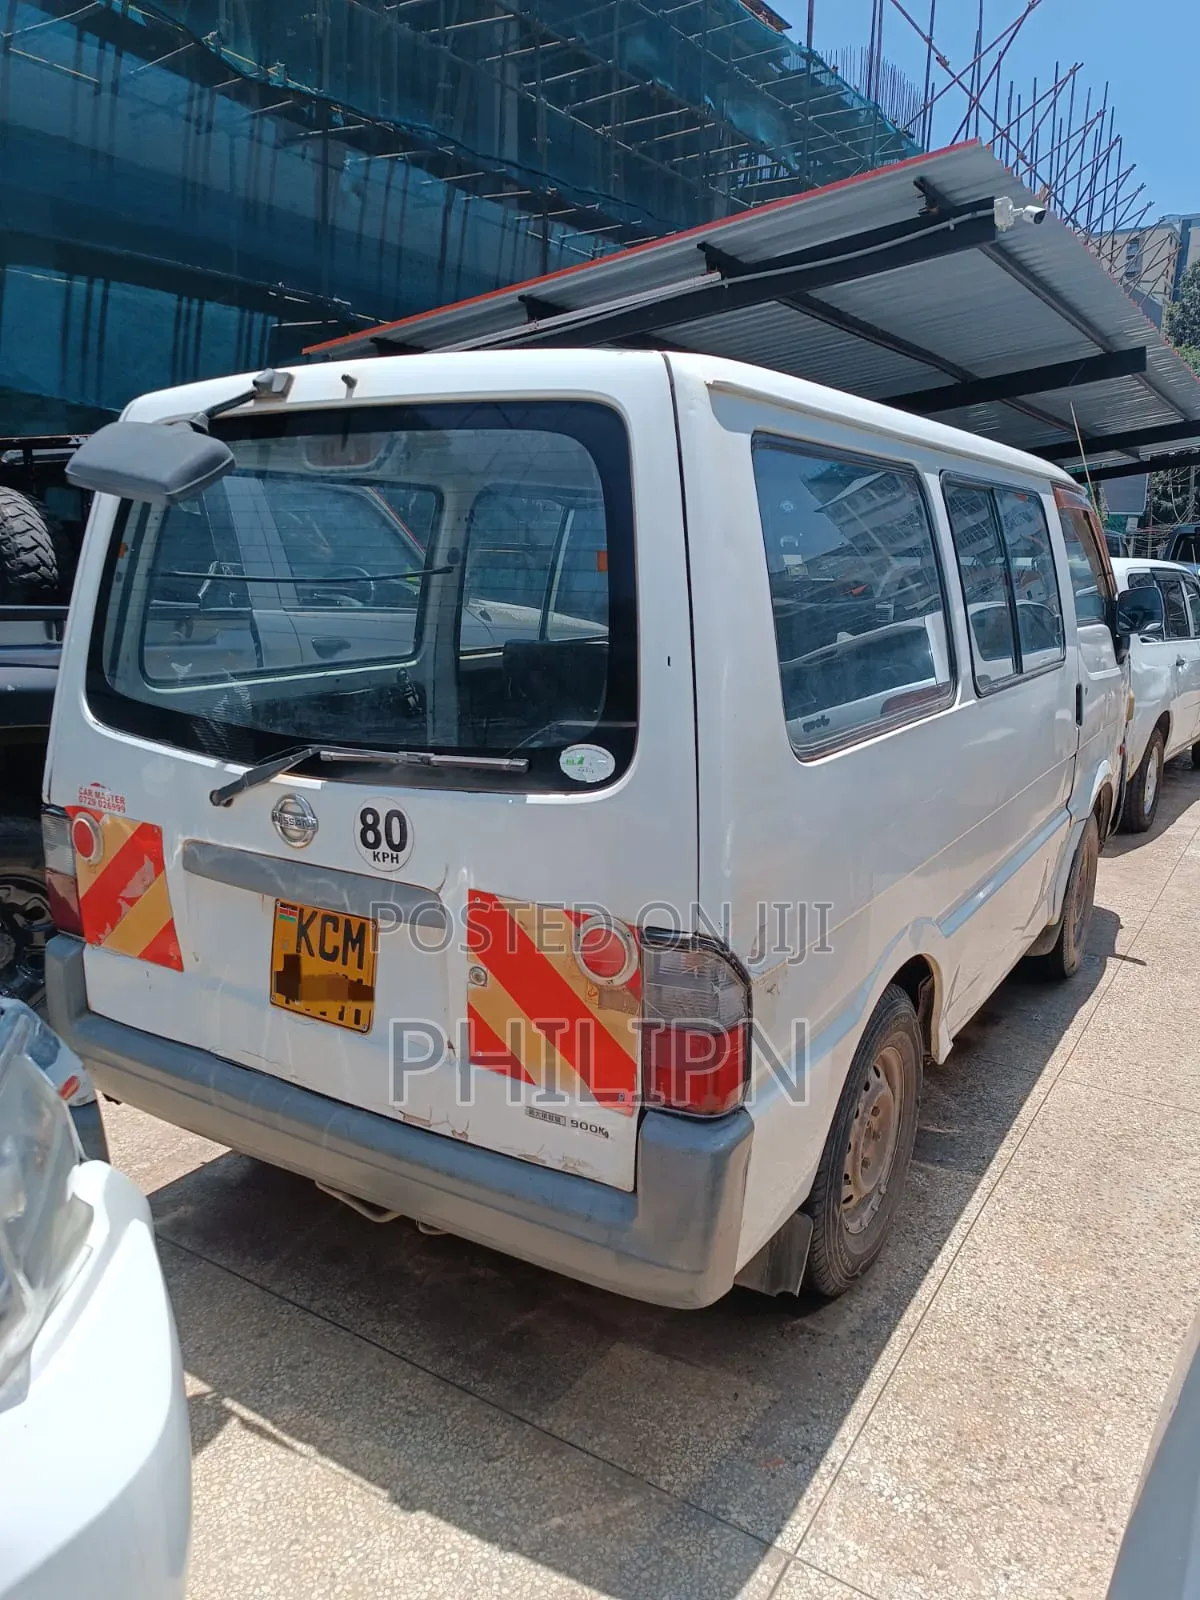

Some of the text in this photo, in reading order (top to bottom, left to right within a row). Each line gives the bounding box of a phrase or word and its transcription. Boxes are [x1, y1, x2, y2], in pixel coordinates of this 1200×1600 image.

[79, 787, 93, 798] CAR
[360, 807, 408, 852] 80
[372, 850, 400, 865] KPH
[296, 907, 366, 970] KCM
